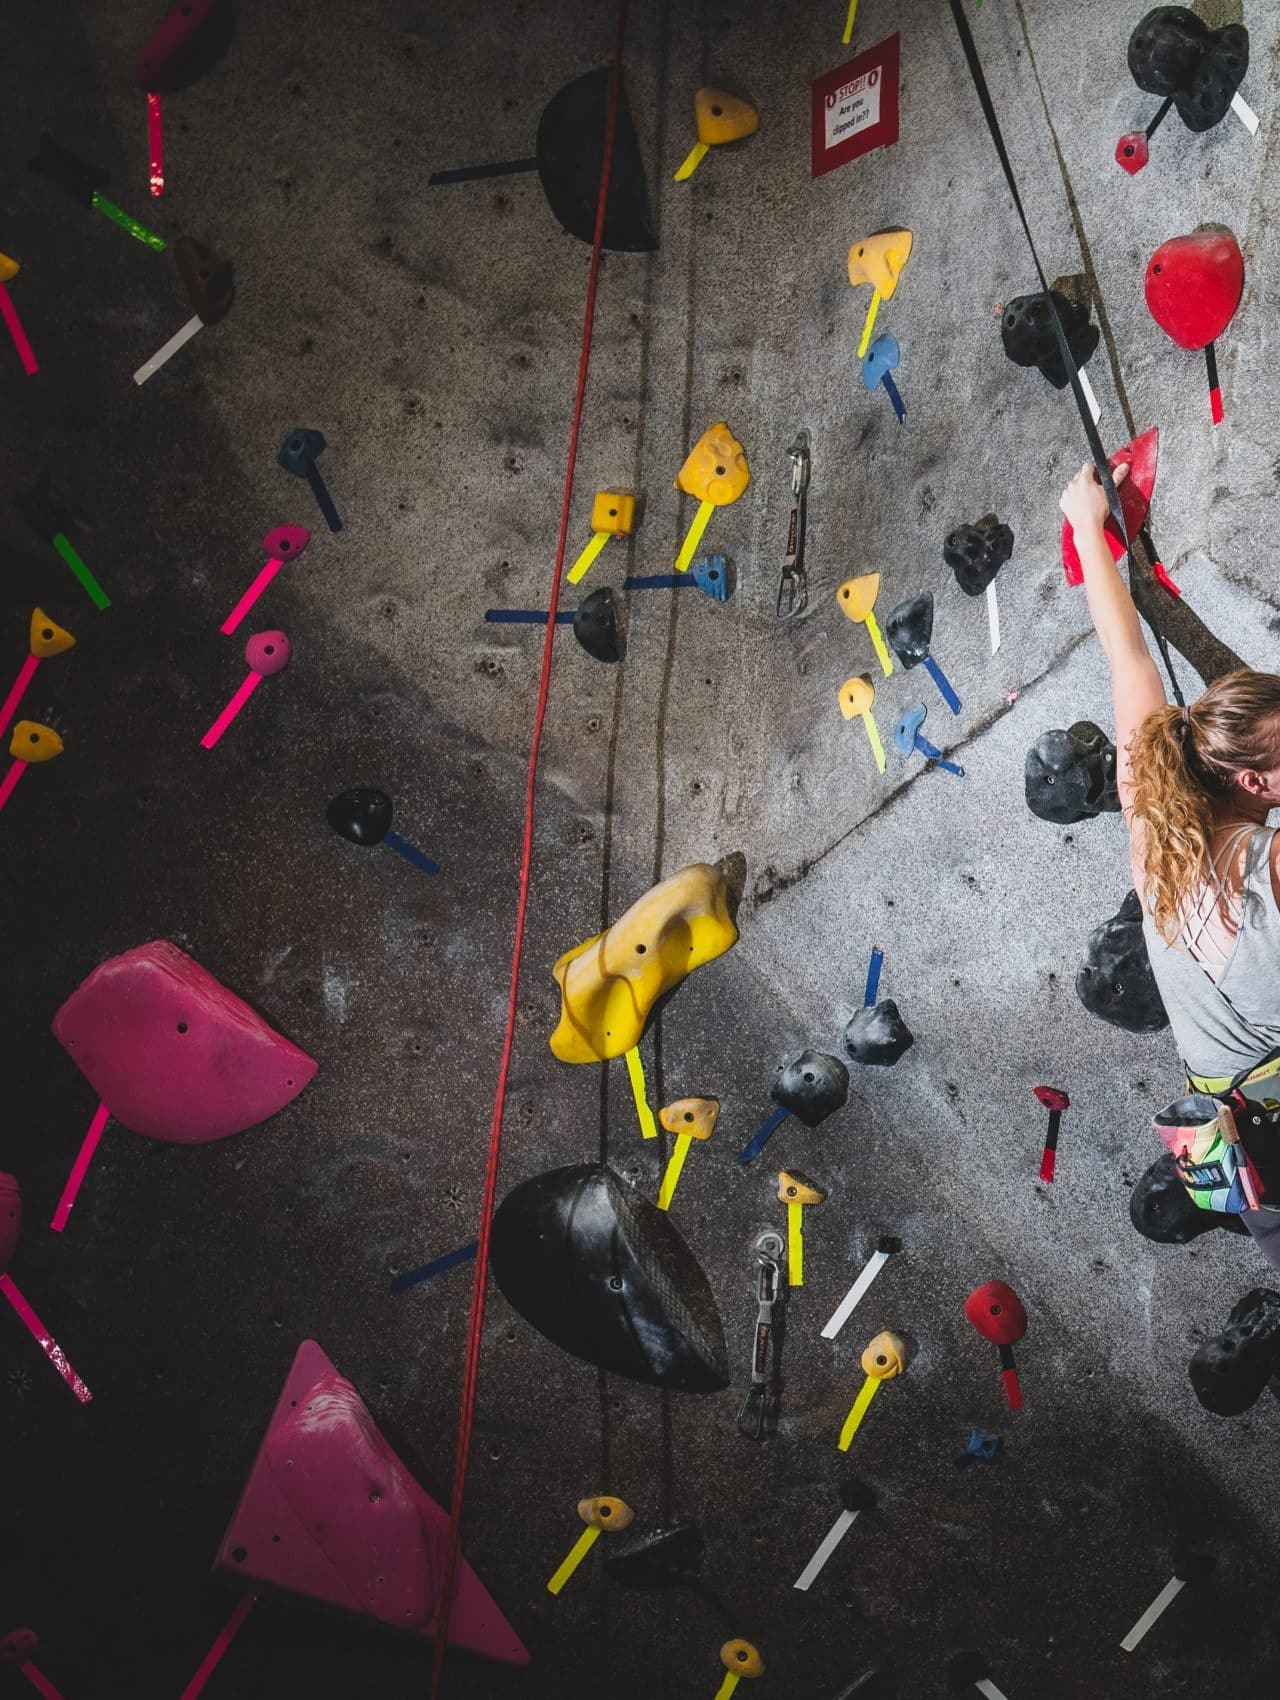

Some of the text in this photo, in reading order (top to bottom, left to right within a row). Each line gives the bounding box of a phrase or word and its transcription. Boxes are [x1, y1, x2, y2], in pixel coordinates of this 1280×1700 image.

[839, 76, 867, 100] STOP!!
[839, 98, 864, 116] Are you
[832, 116, 855, 136] clipped
